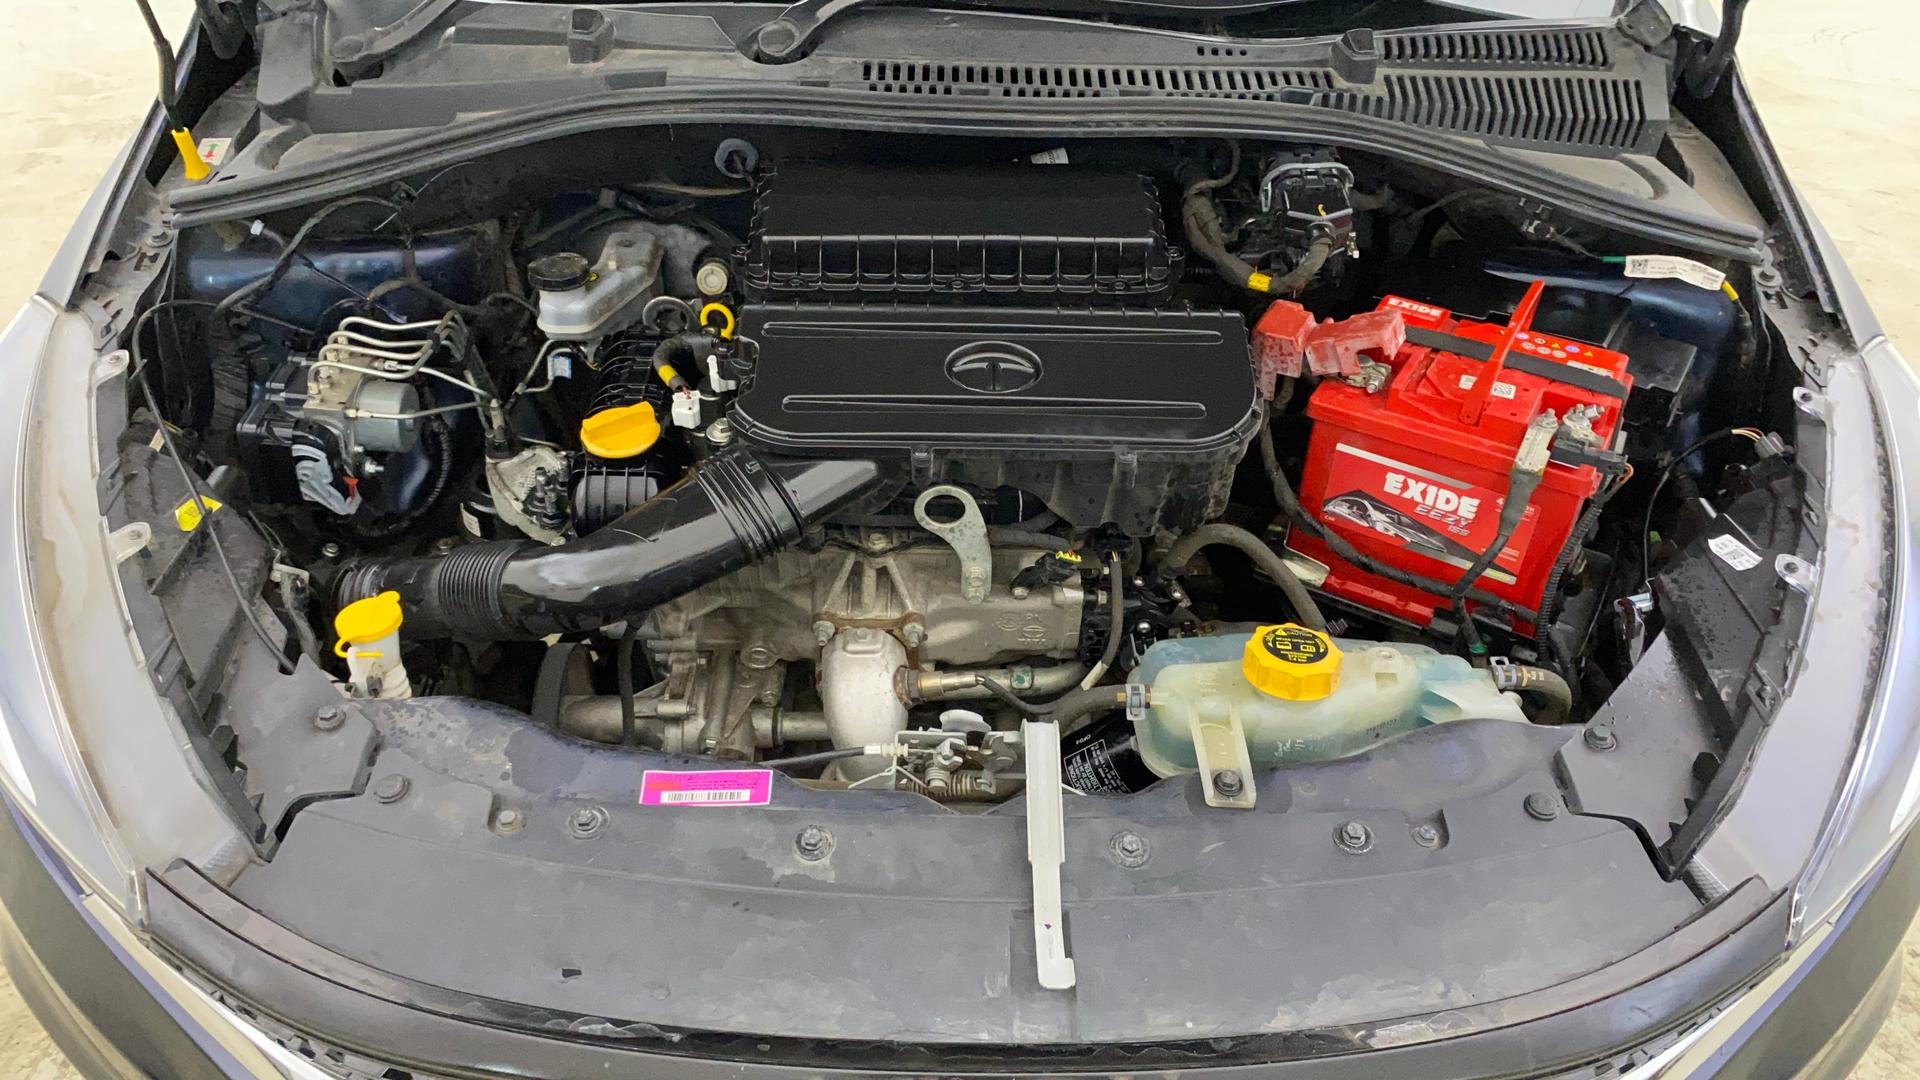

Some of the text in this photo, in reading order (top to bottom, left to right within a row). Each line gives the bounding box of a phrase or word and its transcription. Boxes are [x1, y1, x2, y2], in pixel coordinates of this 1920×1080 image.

[1388, 298, 1442, 317] EXIDE
[1383, 471, 1481, 520] EXIDE
[1414, 503, 1473, 528] EEZY
